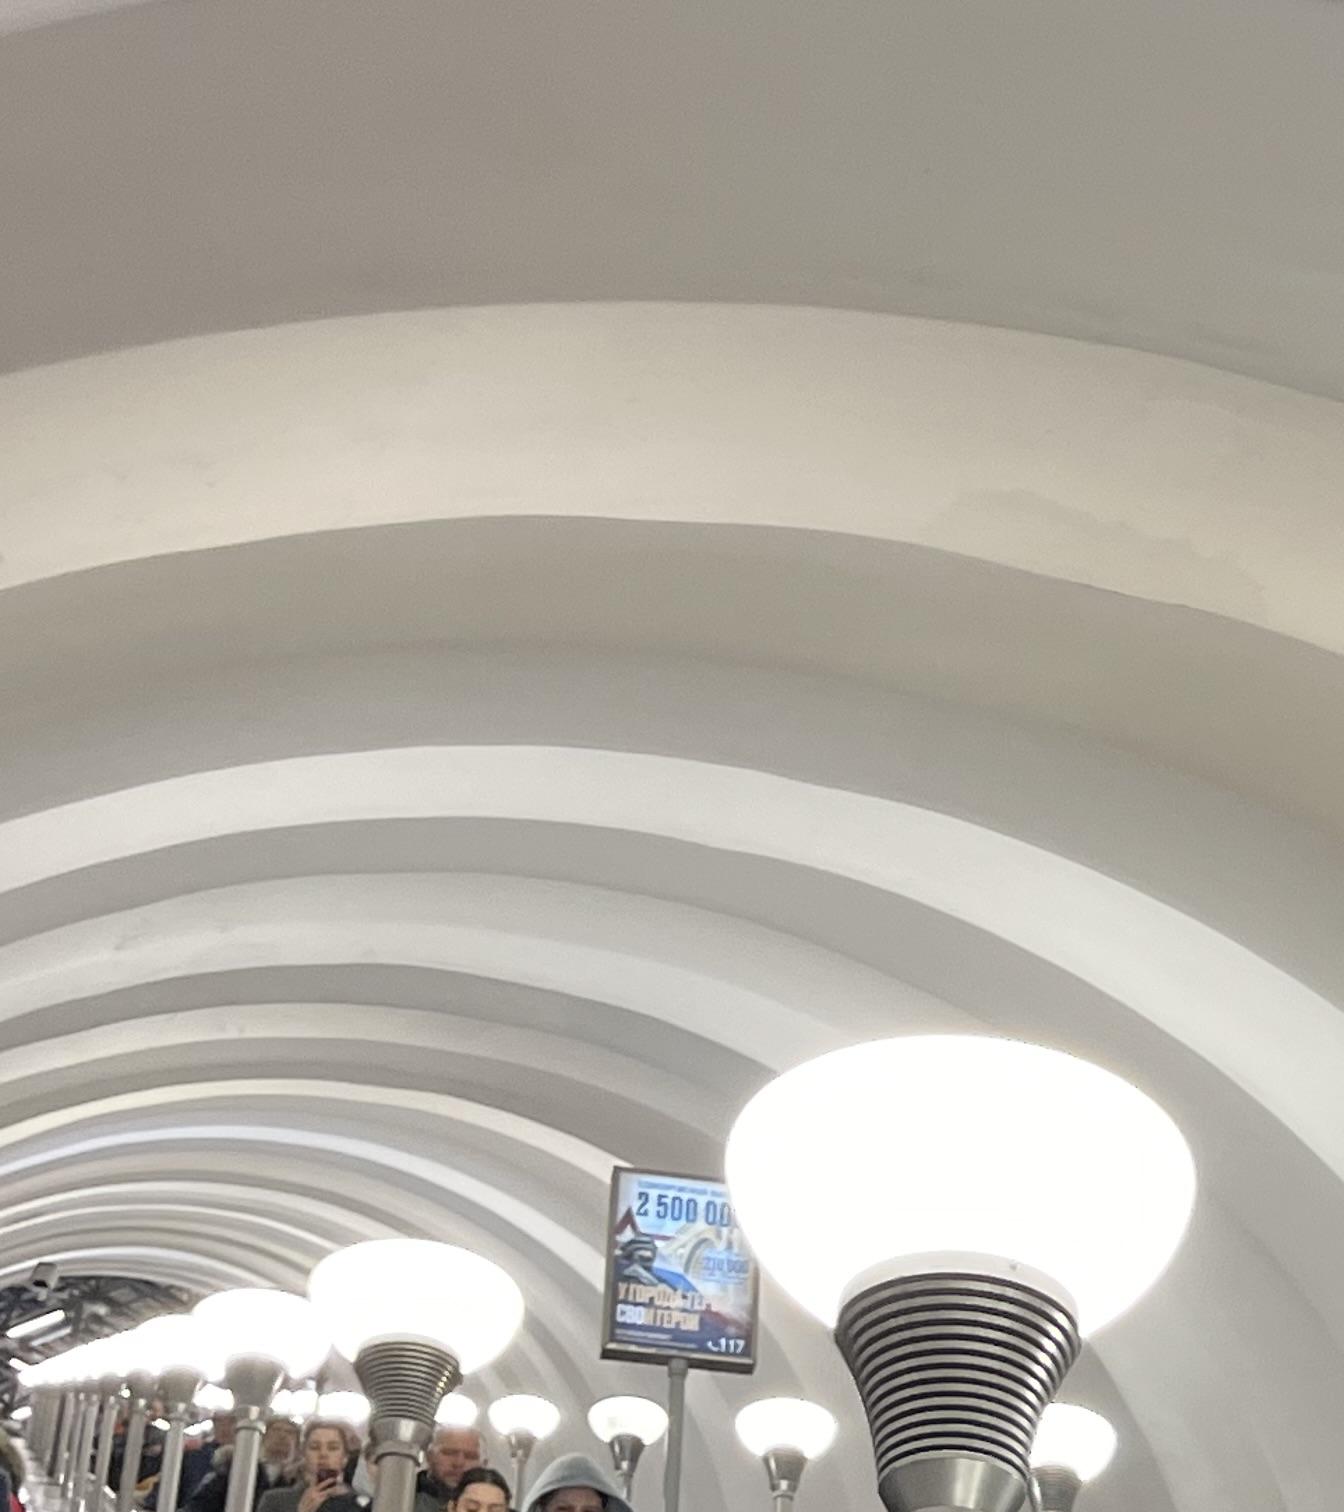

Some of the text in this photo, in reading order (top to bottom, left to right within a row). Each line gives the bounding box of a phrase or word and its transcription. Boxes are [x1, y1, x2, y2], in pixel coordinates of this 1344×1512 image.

[636, 1191, 736, 1227] 2 500 00
[720, 1336, 746, 1354] 117
